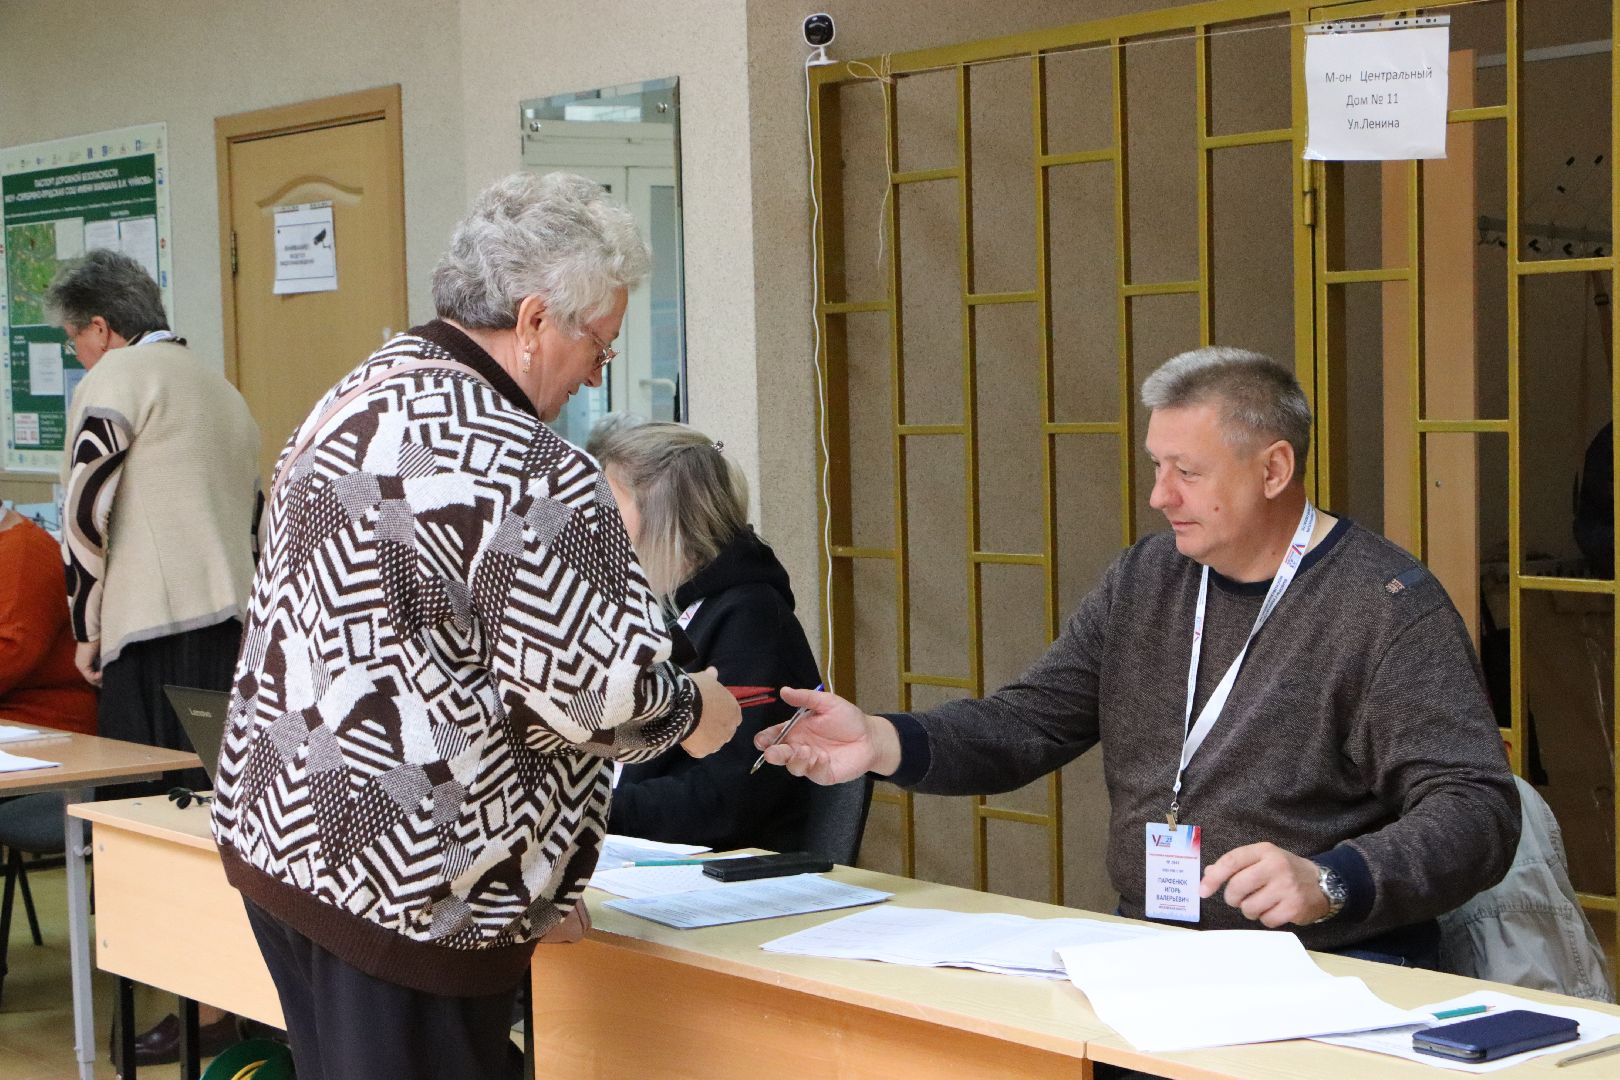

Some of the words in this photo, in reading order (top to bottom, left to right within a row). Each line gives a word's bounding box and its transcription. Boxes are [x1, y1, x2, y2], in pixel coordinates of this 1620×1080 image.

[1325, 72, 1352, 83] М-он
[1360, 66, 1433, 83] Центральный
[1346, 93, 1368, 108] Дом
[1371, 93, 1383, 105] №
[1387, 93, 1399, 105] 11
[1347, 118, 1400, 130] Ул.Ленина
[1164, 886, 1181, 894] ИГОРЬ
[1156, 894, 1190, 903] ВАЛЕРЬЕВИЧ
